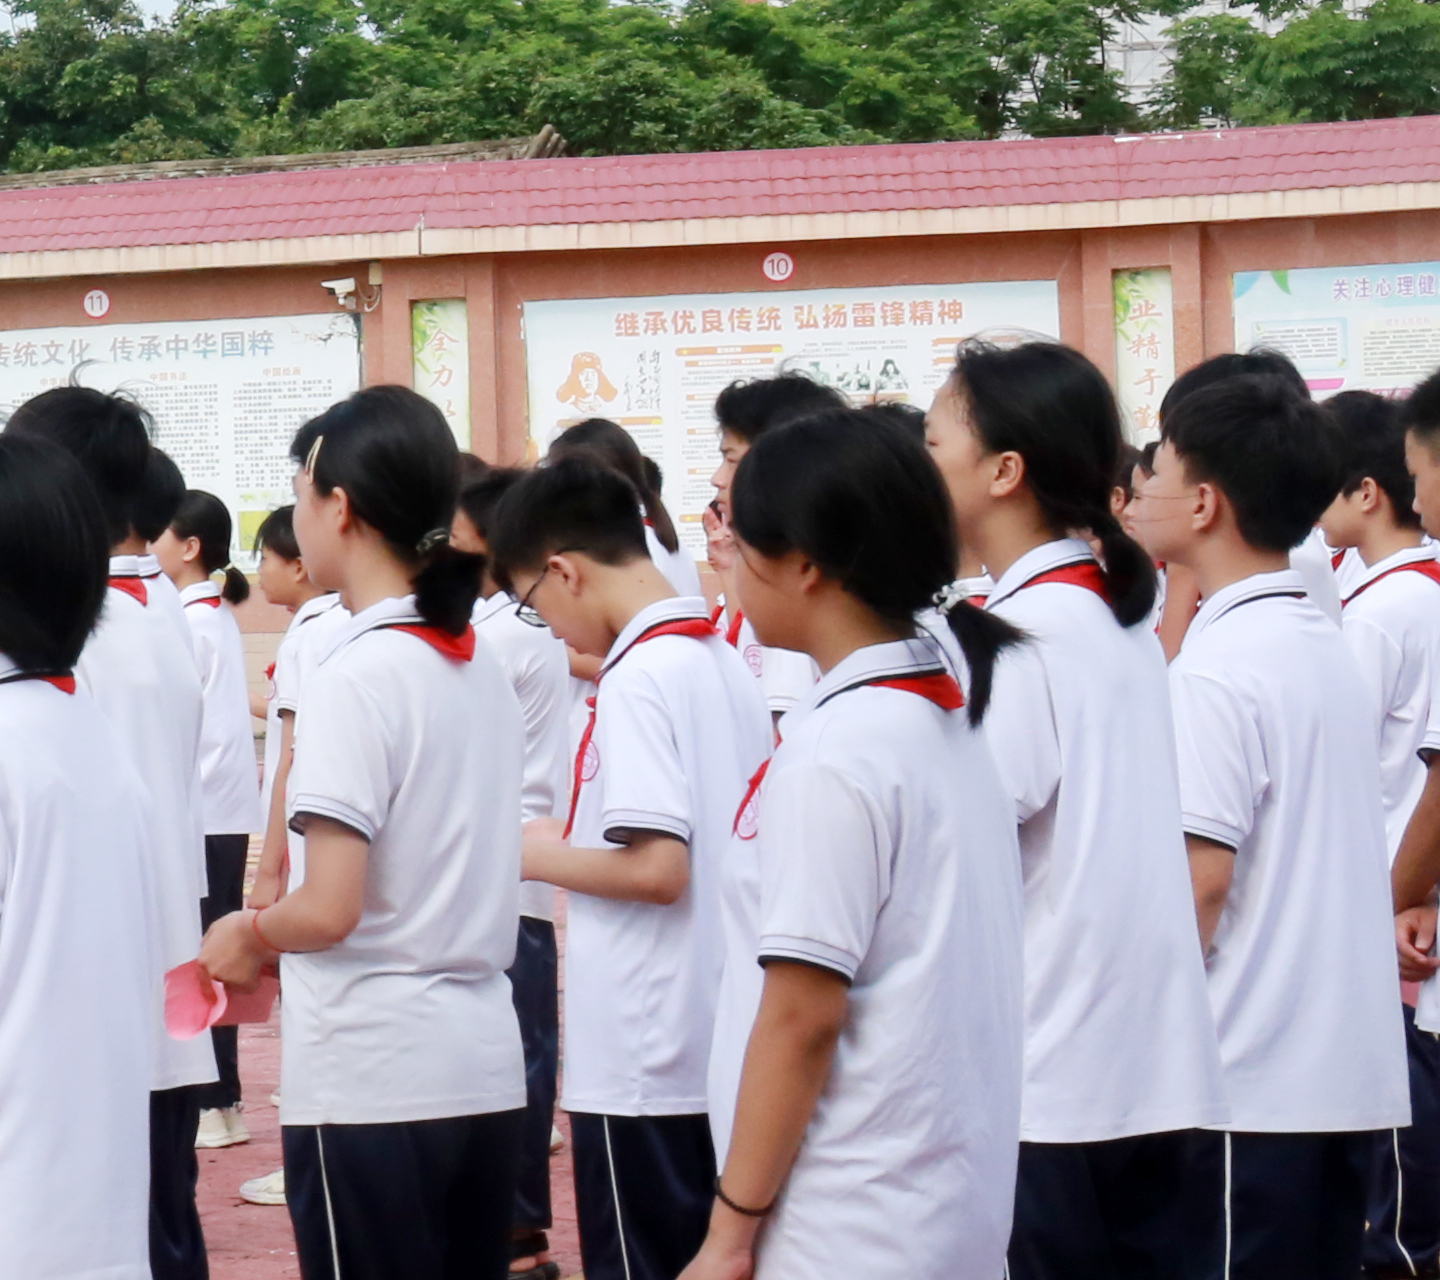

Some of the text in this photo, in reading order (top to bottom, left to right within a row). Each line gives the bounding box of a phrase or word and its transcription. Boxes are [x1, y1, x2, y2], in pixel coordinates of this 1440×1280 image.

[768, 259, 788, 276] 10
[1332, 275, 1440, 301] 关注心理健
[88, 295, 105, 311] 11
[615, 299, 964, 338] 继承优良传统 弘扬雷锋精神
[109, 329, 275, 362] 传承中华国粹
[1126, 299, 1162, 431] 业精于勤
